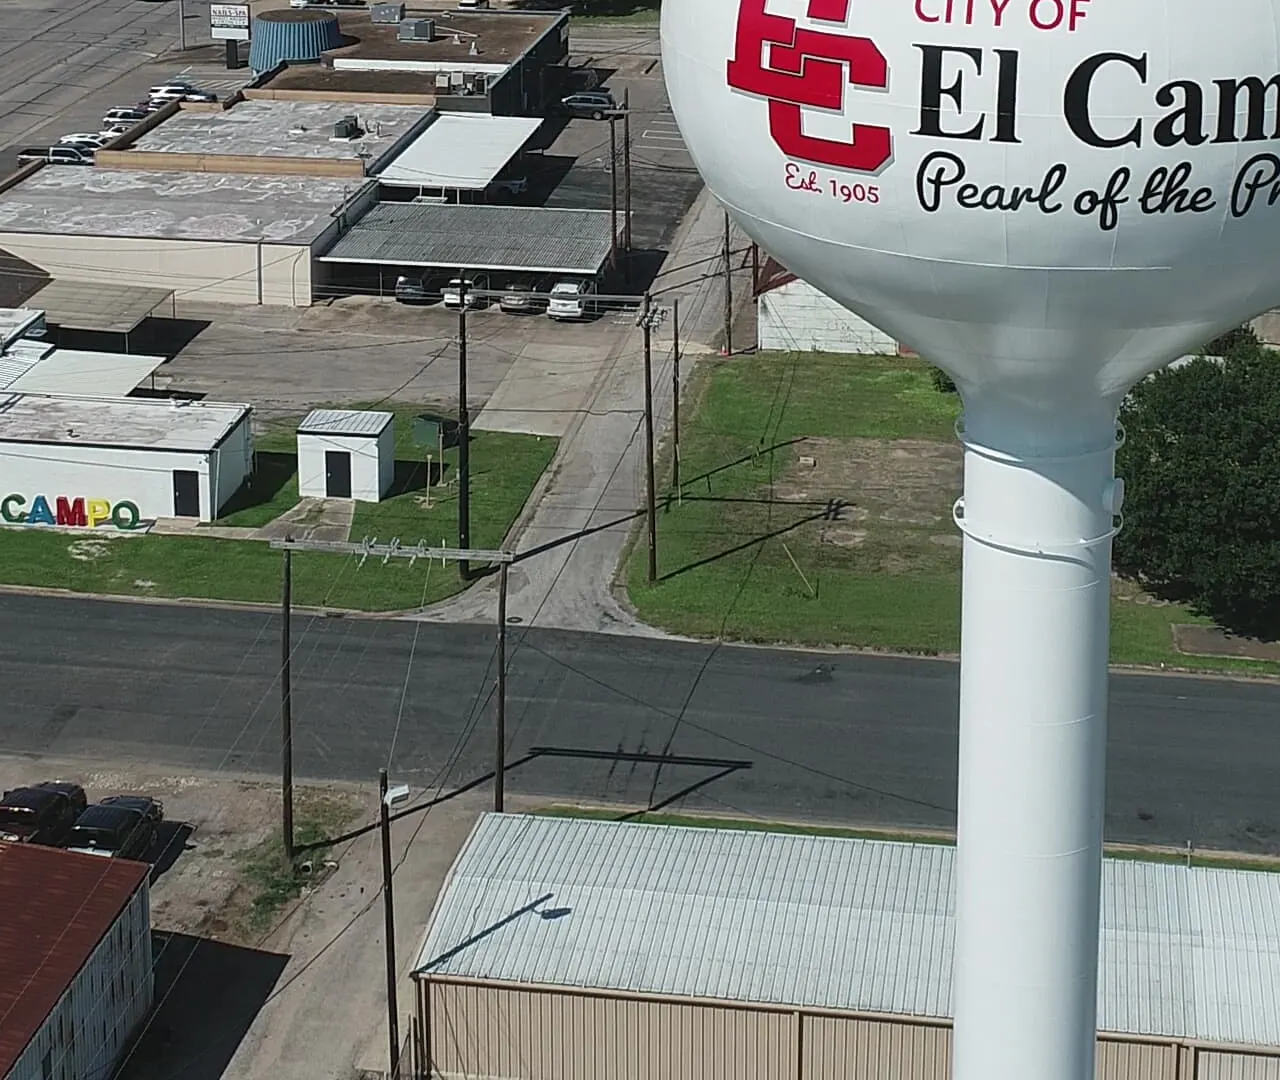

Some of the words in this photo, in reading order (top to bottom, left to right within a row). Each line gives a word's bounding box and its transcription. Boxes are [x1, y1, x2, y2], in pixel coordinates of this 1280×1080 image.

[910, 43, 1022, 145] El
[785, 163, 823, 193] Est.
[829, 179, 880, 204] 1905
[916, 151, 1067, 214] Pearl
[1073, 166, 1131, 231] of
[1137, 161, 1217, 215] the
[0, 493, 141, 530] CAMPO
